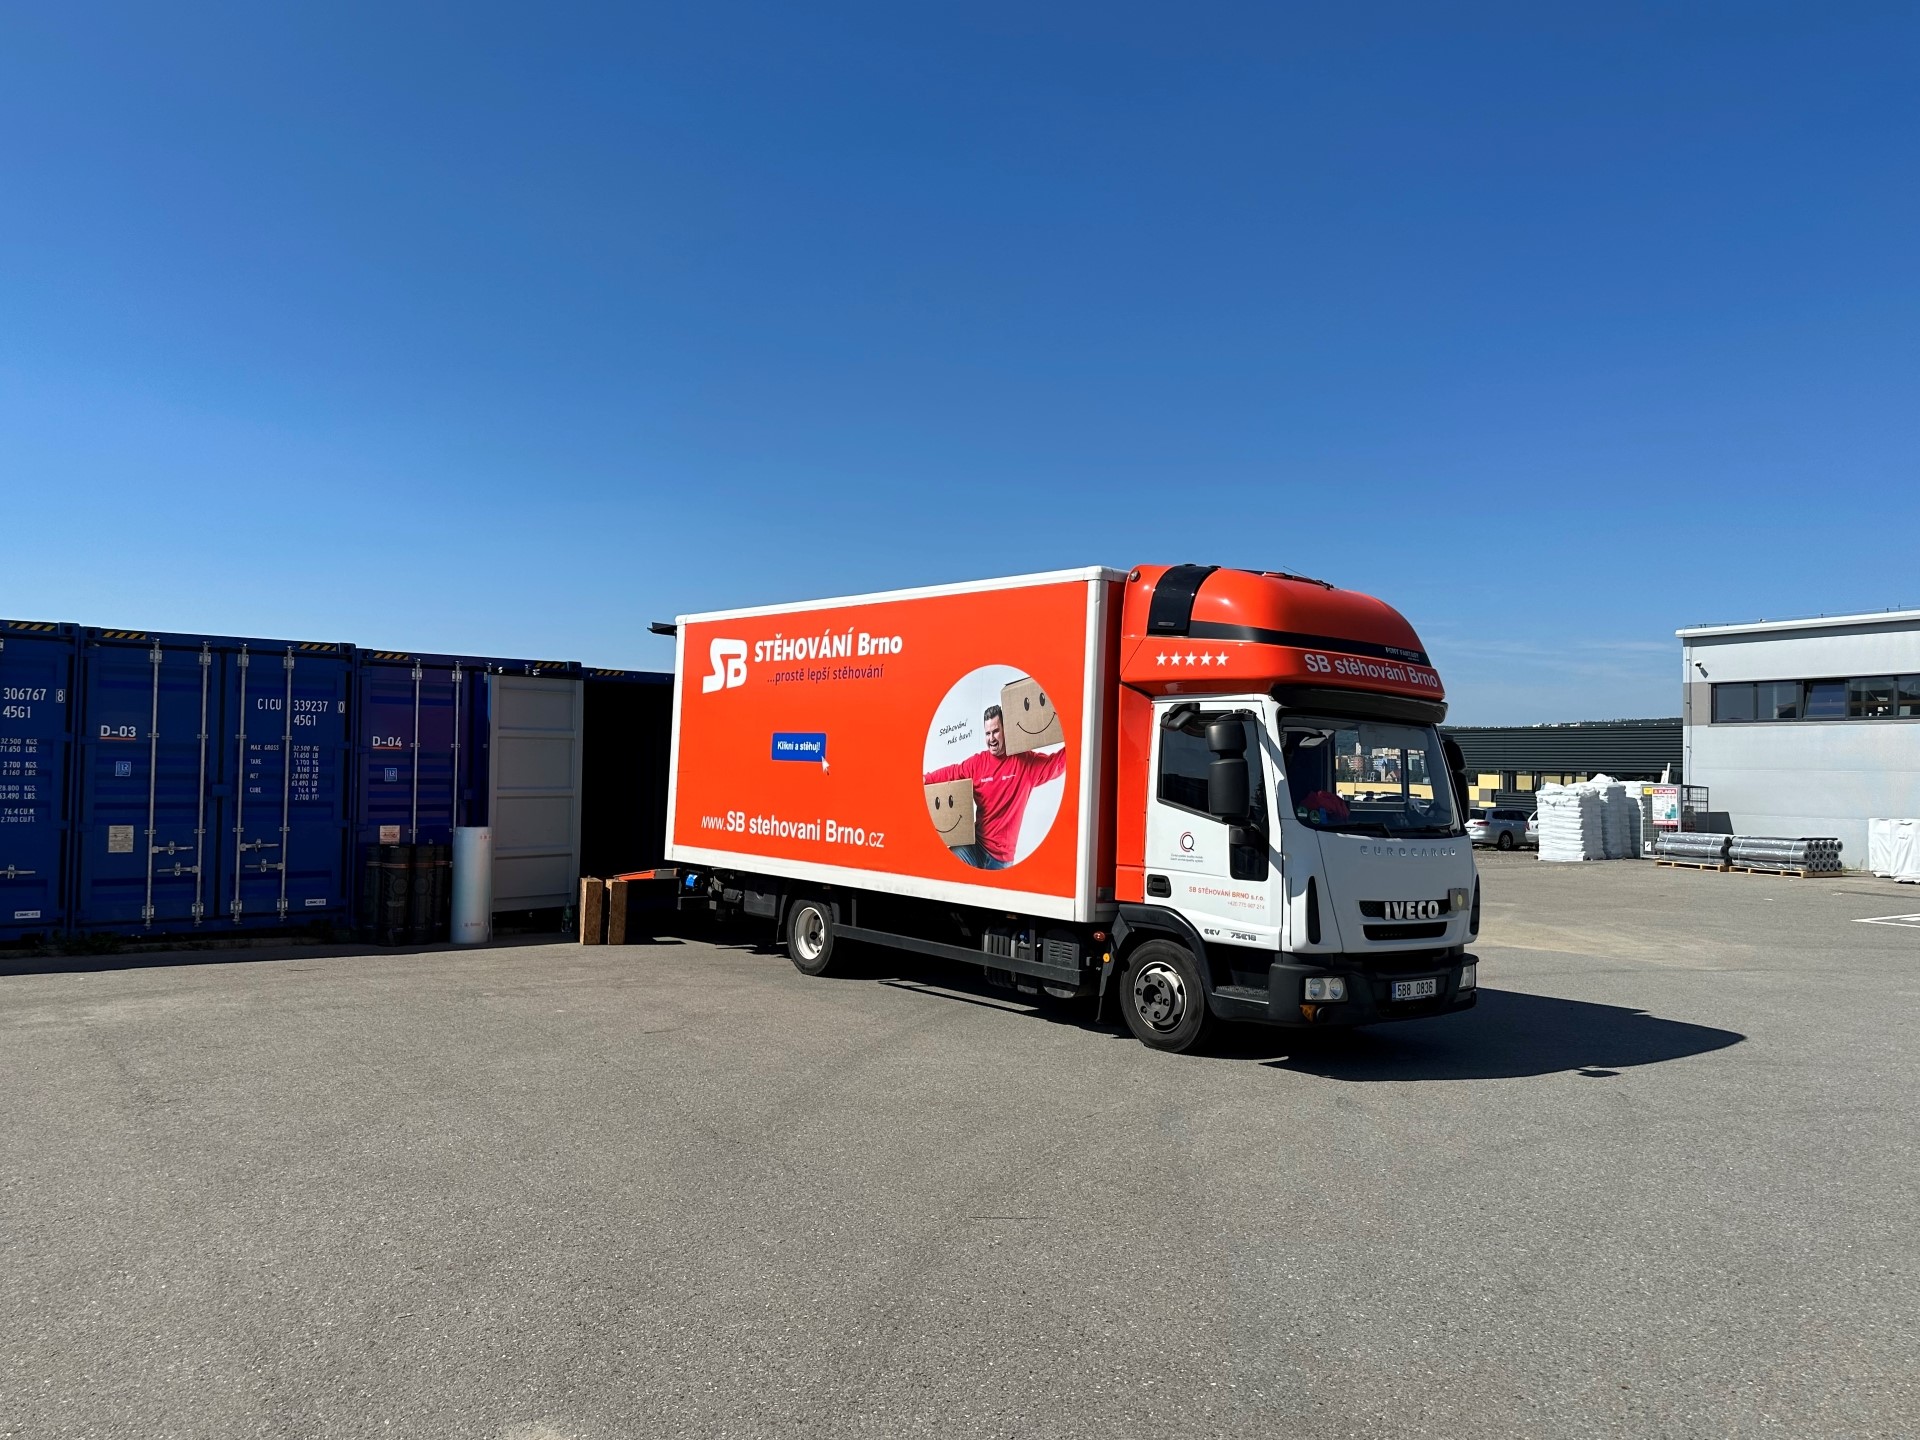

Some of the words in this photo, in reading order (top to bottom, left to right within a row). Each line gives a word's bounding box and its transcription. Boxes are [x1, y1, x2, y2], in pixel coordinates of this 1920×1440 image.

[754, 627, 854, 663] STĚHOVÁNÍ
[857, 632, 903, 656] Brno
[702, 637, 748, 694] SB
[1304, 653, 1331, 673] SB
[1334, 657, 1407, 682] stěhování
[1407, 666, 1438, 688] Brno
[767, 668, 805, 685] ...prostě
[807, 666, 831, 684] lepší
[833, 664, 885, 680] stěhování
[3, 687, 47, 701] 306767
[57, 690, 64, 702] 8
[2, 705, 31, 719] 45G1
[257, 698, 282, 711] CICU
[293, 699, 329, 713] 339237
[338, 701, 344, 713] 0
[293, 714, 317, 727] 45G1
[100, 725, 137, 738] D-03
[372, 735, 402, 747] D-04
[777, 740, 794, 750] Klikni
[794, 743, 799, 751] a
[749, 814, 821, 841] stehovani
[825, 819, 885, 848] Brno.cz
[1359, 845, 1456, 857] EUROCARGO
[1197, 886, 1231, 897] STĚHOVÁNÍ
[1231, 891, 1250, 900] BRNO
[1384, 900, 1440, 920] IVECO
[1203, 928, 1221, 936] EEV
[1230, 931, 1257, 942] 75E18
[1397, 983, 1411, 997] 5B8
[1416, 981, 1433, 995] 0836
